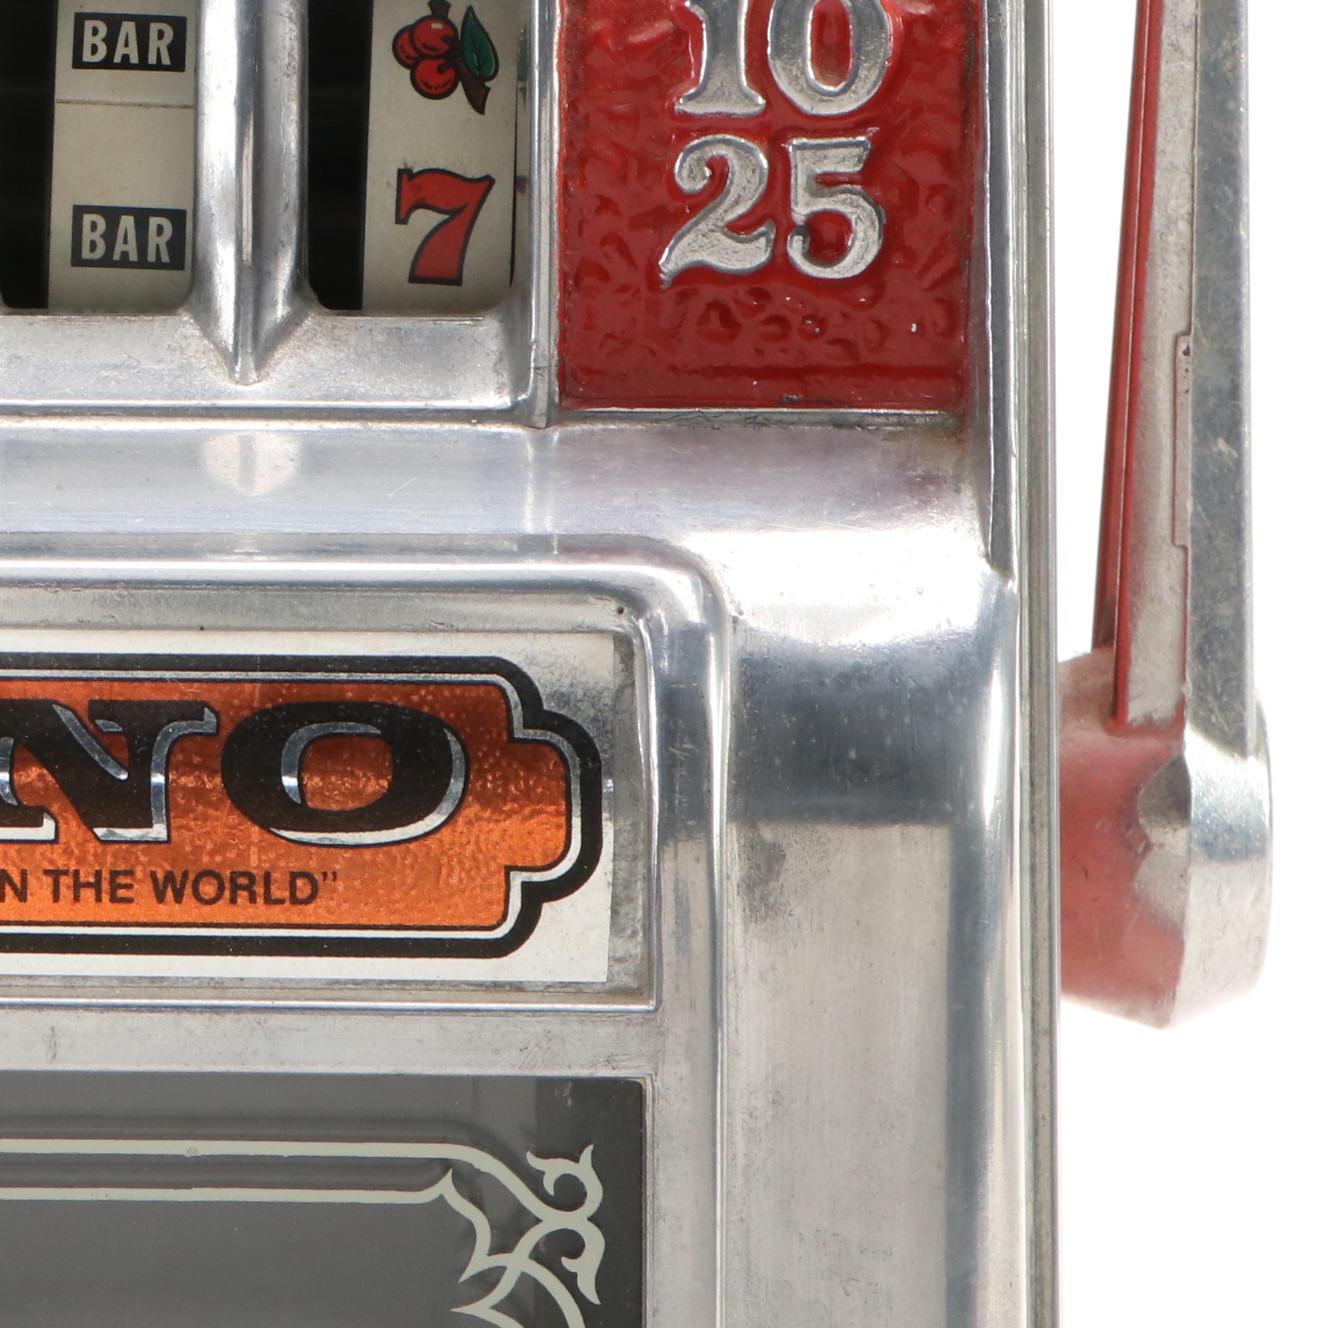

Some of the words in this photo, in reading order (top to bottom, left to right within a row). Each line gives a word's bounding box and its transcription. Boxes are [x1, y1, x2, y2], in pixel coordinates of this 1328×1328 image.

[81, 20, 174, 67] BAR
[395, 168, 496, 286] 7
[658, 133, 884, 289] 25
[80, 215, 173, 263] BAR
[43, 868, 134, 903] THE
